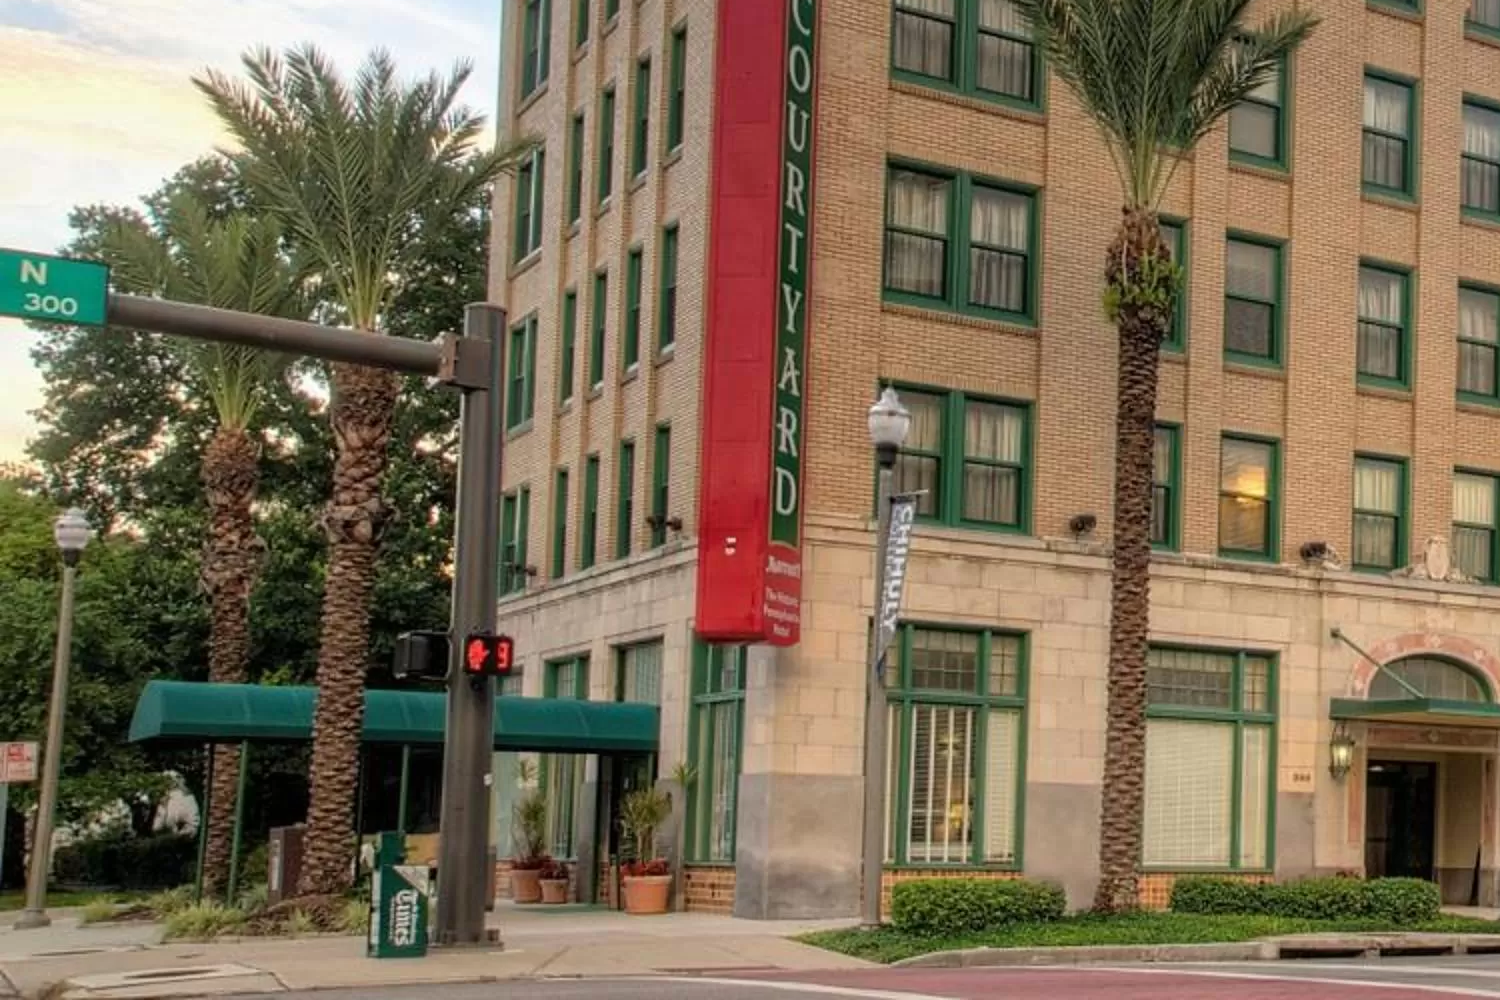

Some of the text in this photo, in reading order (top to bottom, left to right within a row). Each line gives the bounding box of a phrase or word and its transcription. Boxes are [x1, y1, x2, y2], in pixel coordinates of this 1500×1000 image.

[21, 260, 47, 285] N
[23, 293, 78, 315] 300
[882, 505, 914, 632] CHIHULY
[497, 642, 509, 668] 9
